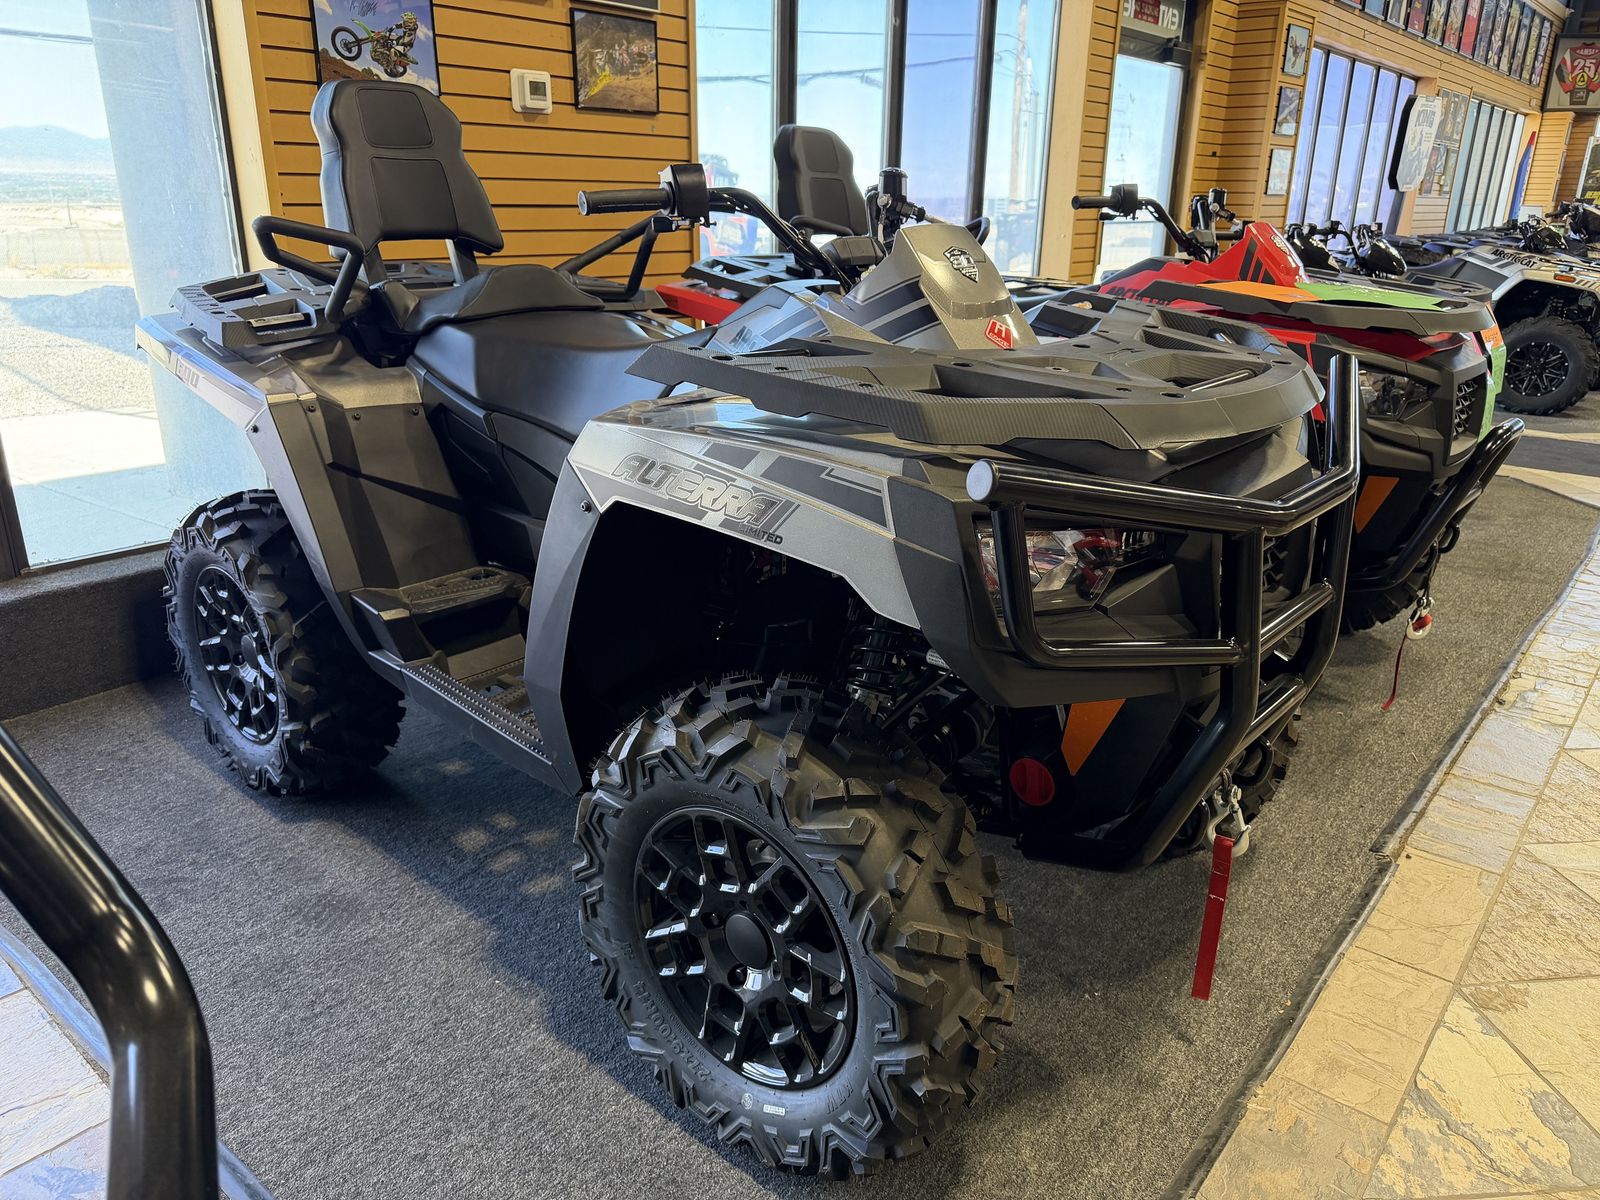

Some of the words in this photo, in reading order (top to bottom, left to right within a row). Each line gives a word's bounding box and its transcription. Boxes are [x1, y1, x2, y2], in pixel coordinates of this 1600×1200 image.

[1572, 58, 1597, 79] 25
[1491, 248, 1521, 264] ARCTIC
[1520, 259, 1538, 269] CAT
[611, 453, 783, 527] ALTERRA
[740, 522, 783, 546] LIMITED
